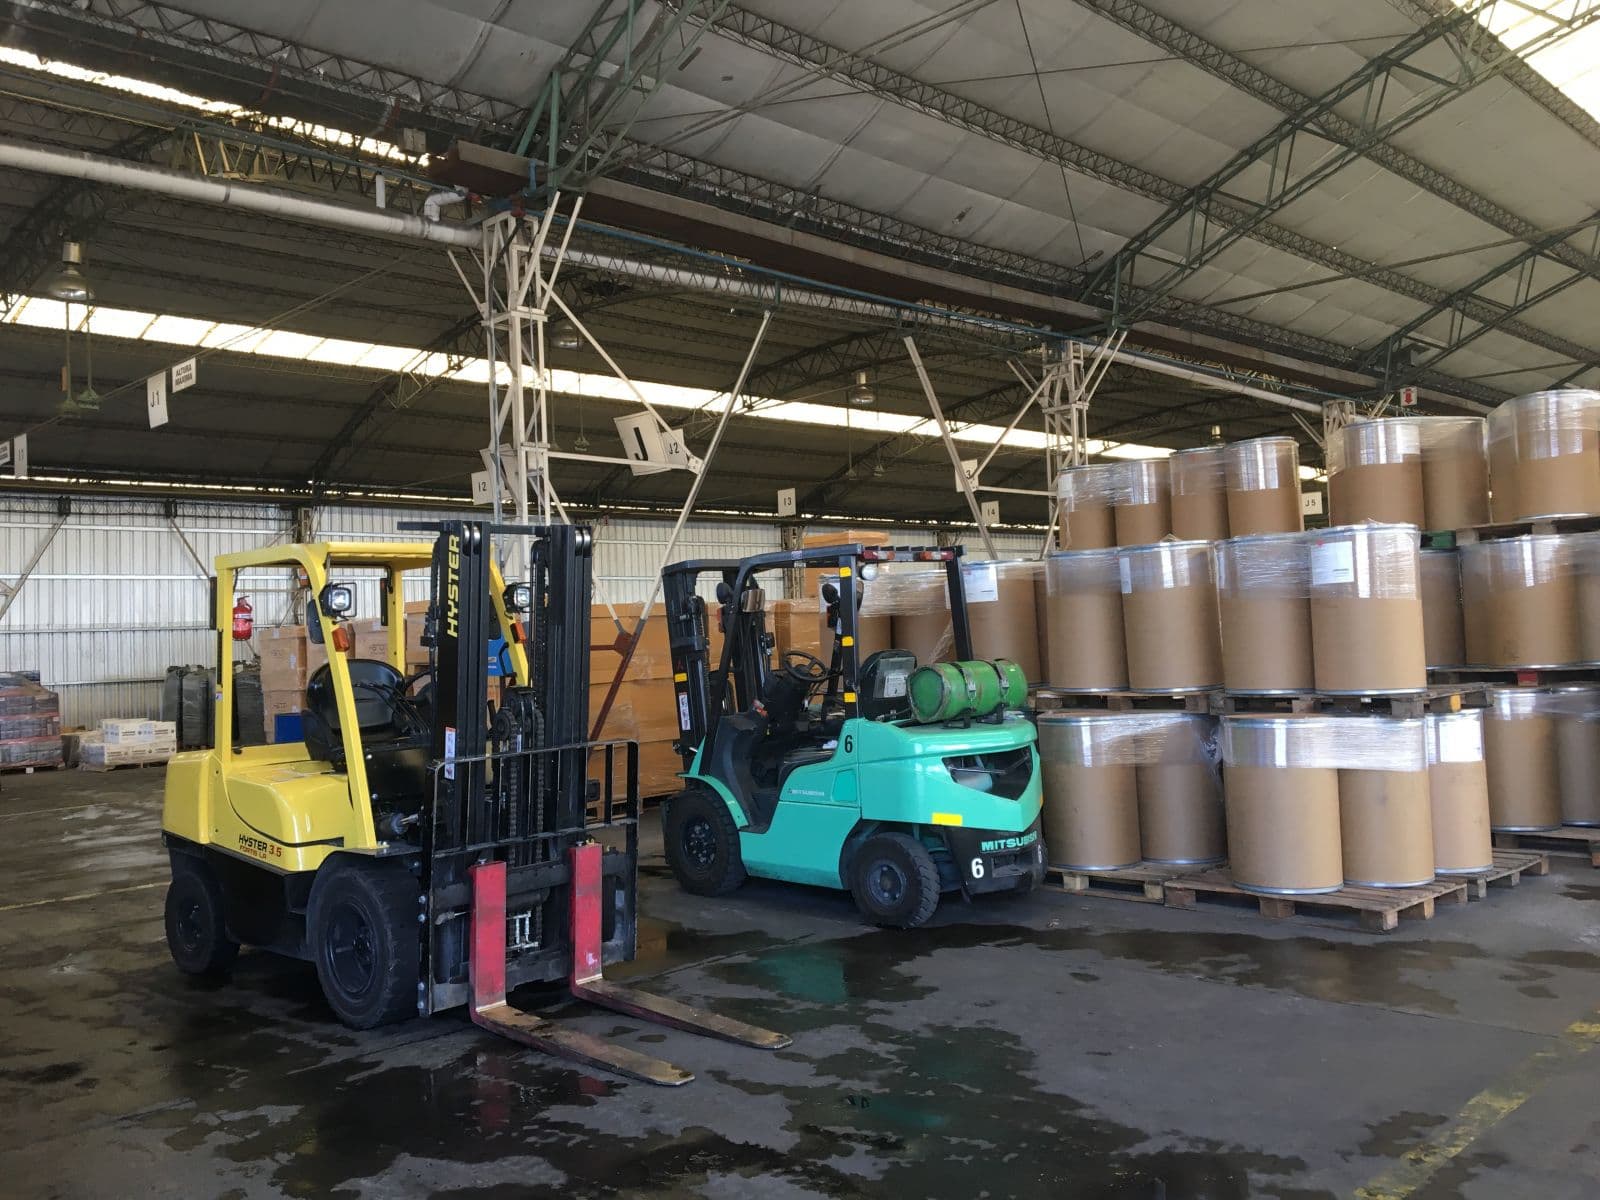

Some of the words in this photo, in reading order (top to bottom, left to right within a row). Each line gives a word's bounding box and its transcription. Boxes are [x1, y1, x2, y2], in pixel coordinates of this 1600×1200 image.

[632, 426, 649, 461] J
[446, 534, 460, 638] HYSTER
[844, 734, 853, 753] 6
[238, 833, 268, 853] HYSTER
[971, 857, 985, 879] 6
